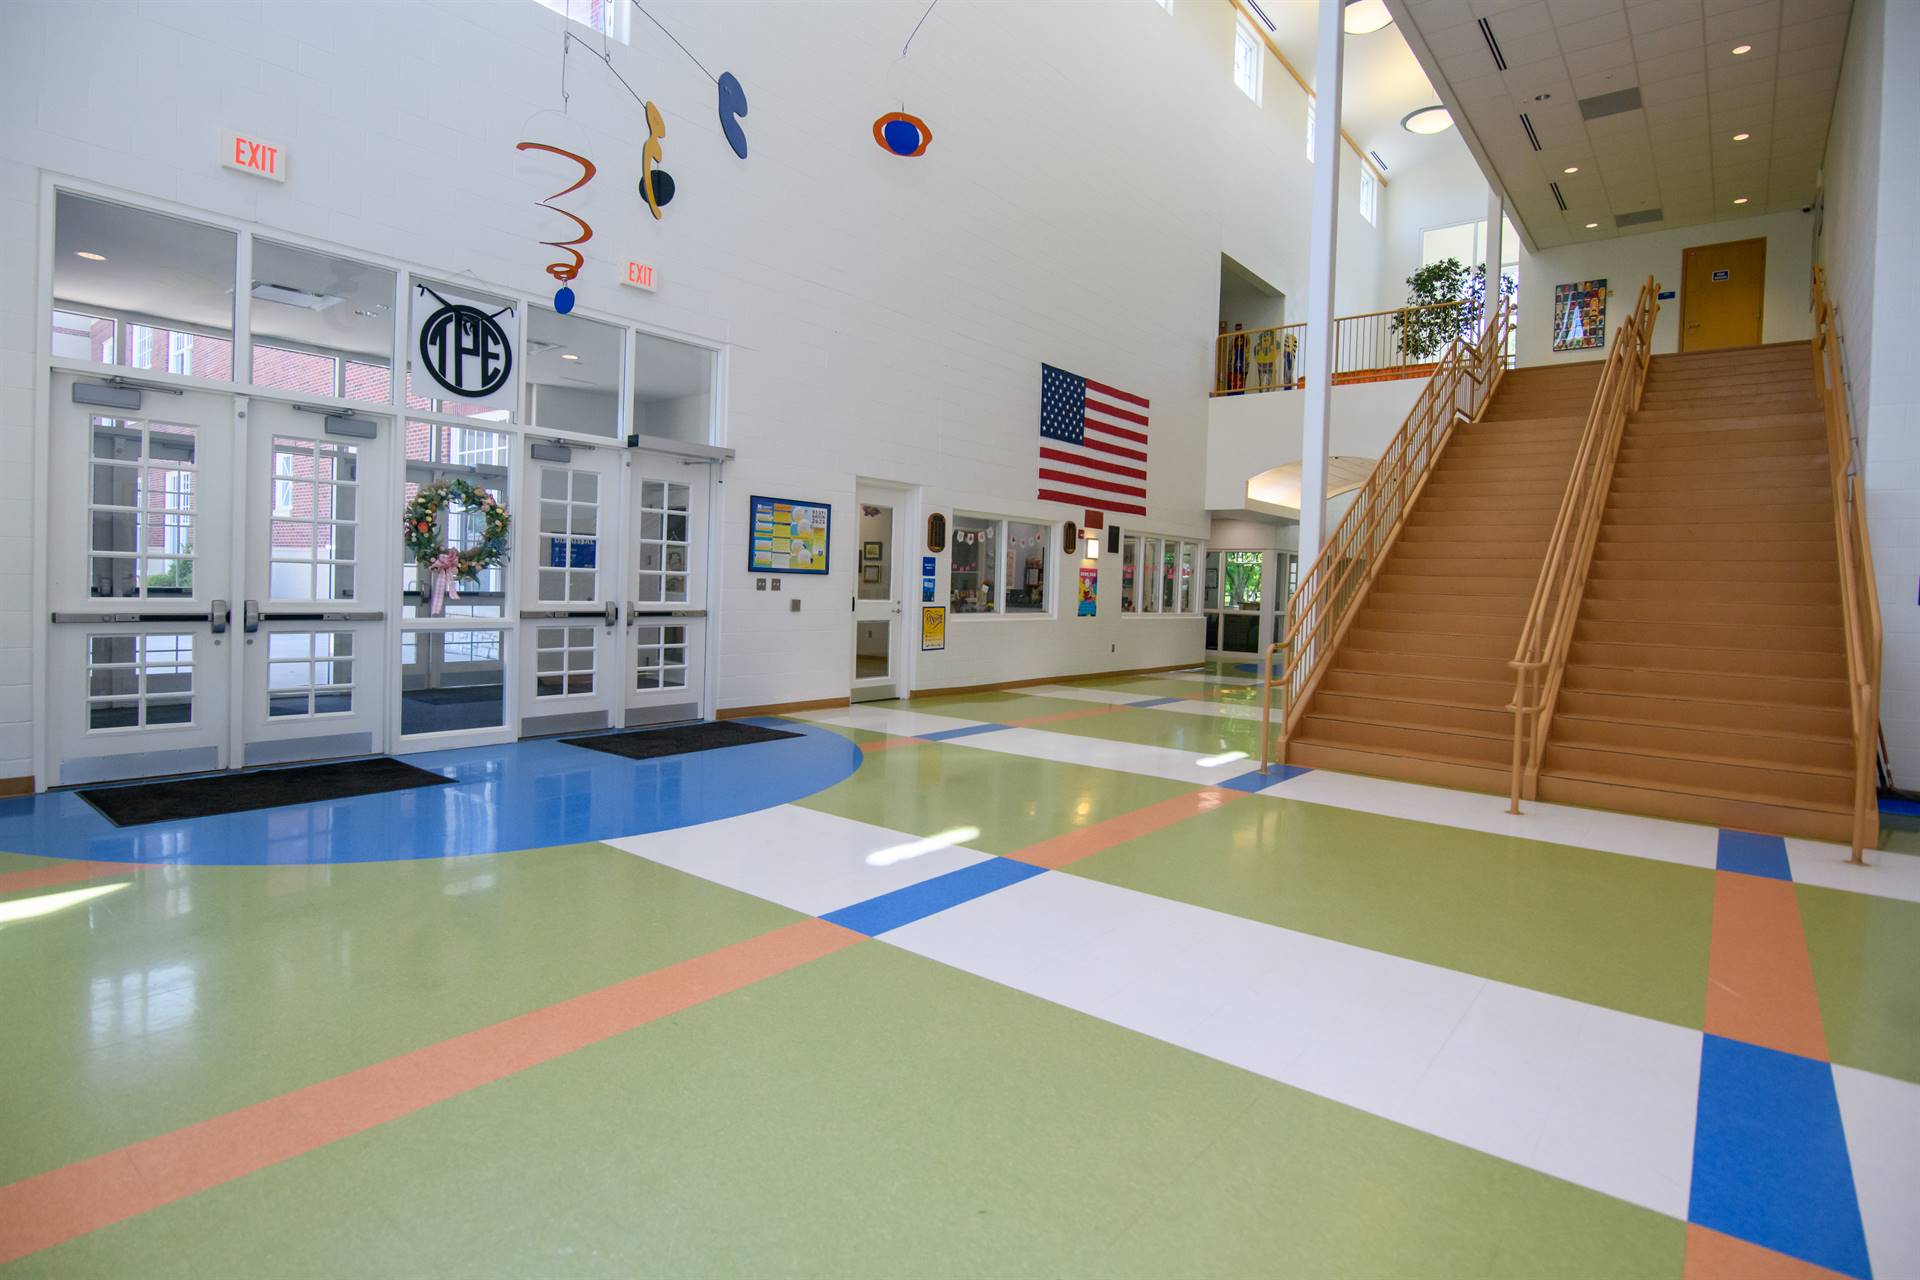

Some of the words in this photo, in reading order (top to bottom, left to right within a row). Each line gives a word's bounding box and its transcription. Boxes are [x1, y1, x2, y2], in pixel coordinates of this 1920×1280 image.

[235, 137, 278, 174] EXIT
[629, 261, 653, 288] EXIT
[428, 311, 501, 389] TPE
